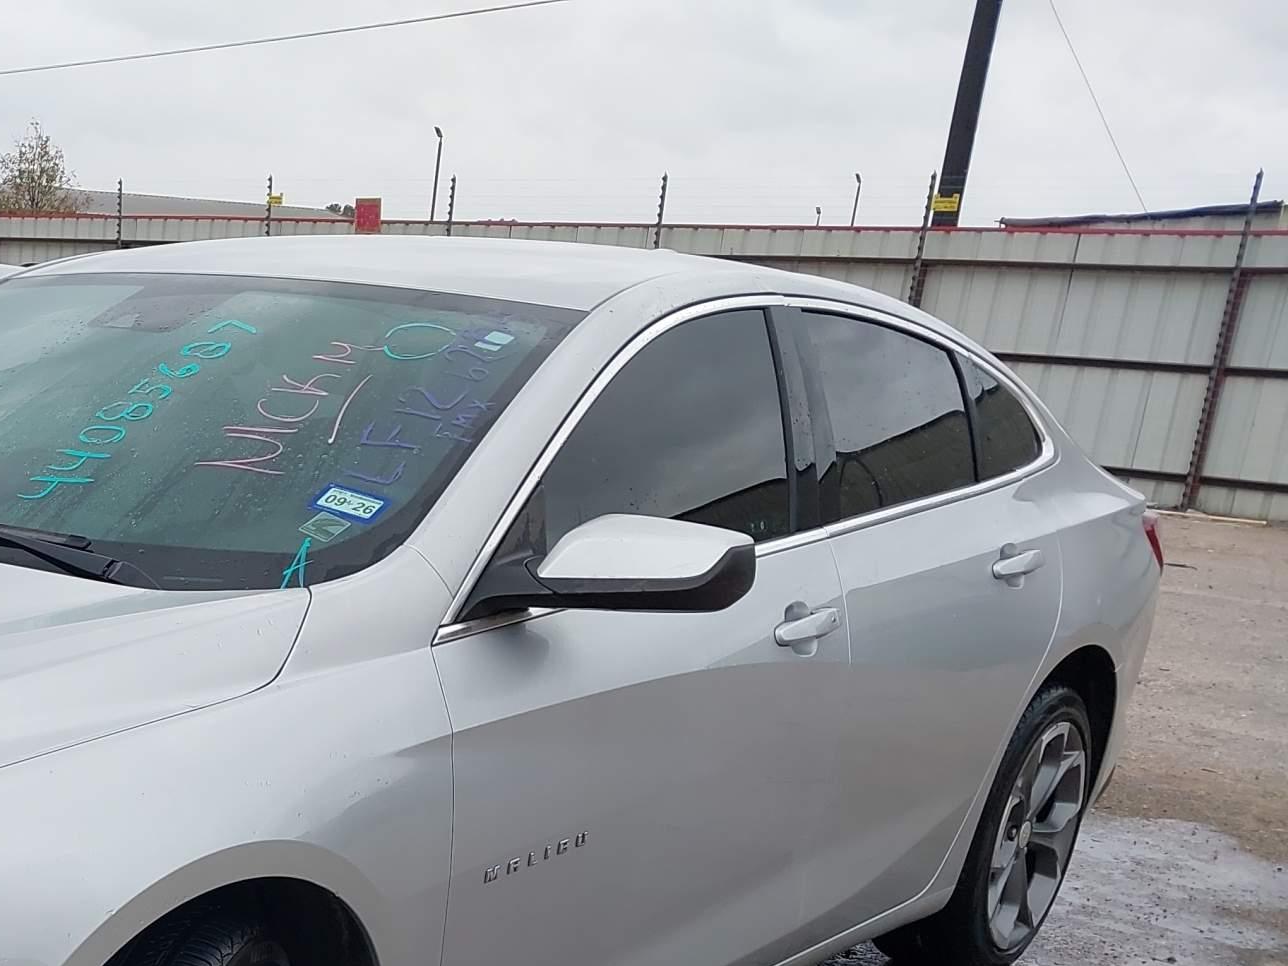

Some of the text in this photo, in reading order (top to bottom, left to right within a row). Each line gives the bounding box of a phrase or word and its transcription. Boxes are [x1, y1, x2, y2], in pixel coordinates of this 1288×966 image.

[16, 319, 258, 501] 44085687
[324, 494, 348, 507] 09
[352, 501, 377, 515] 26
[483, 830, 589, 884] MALIBU
